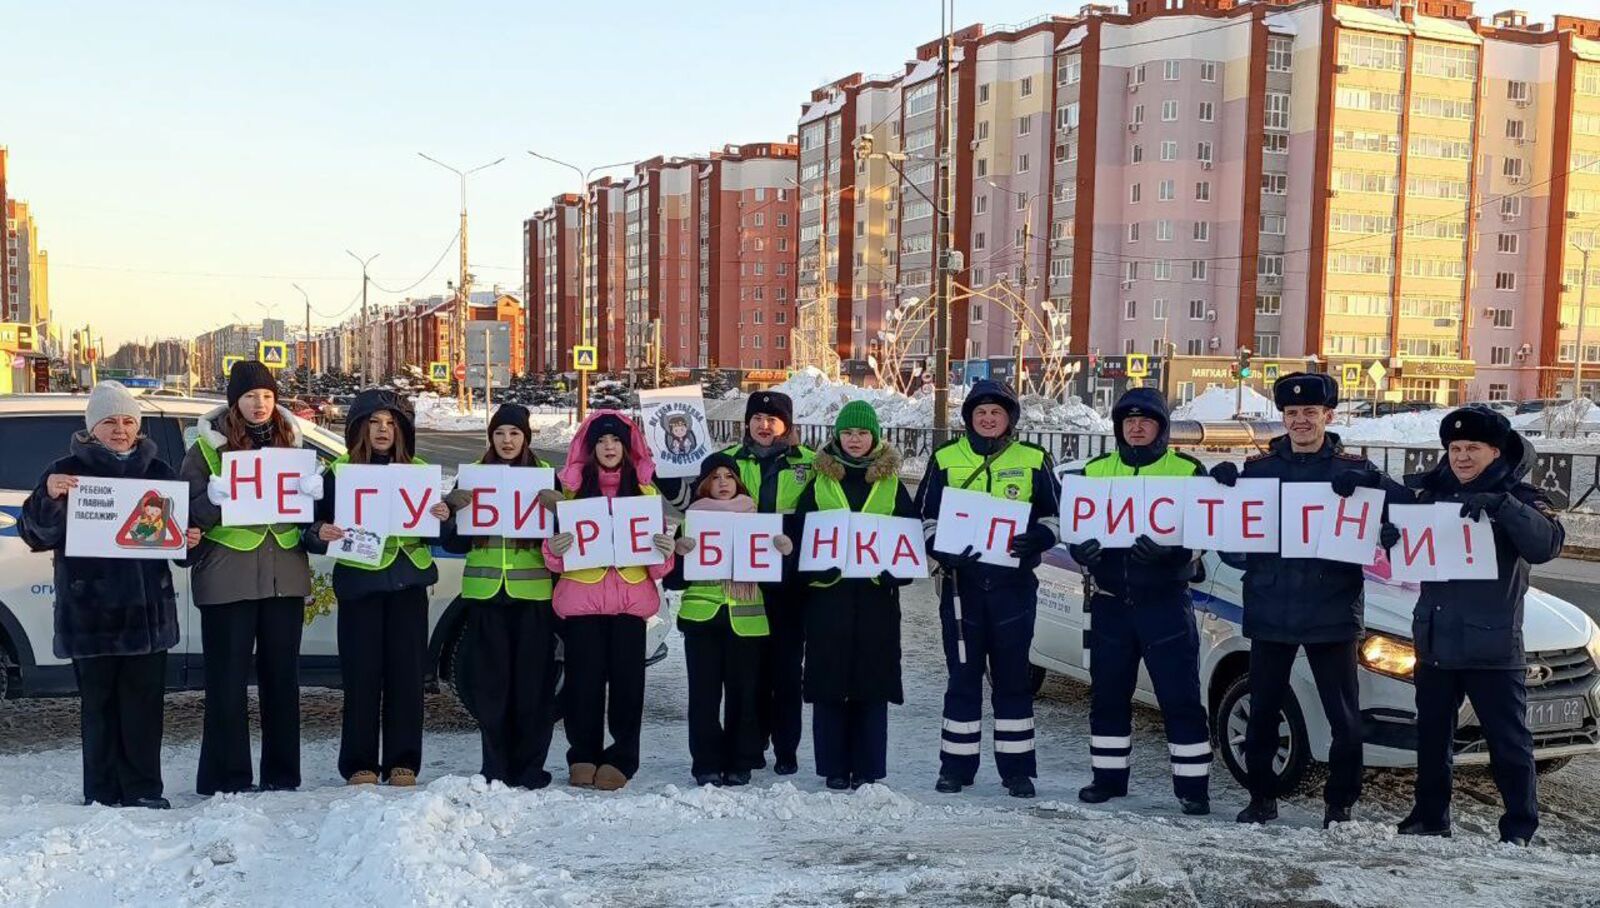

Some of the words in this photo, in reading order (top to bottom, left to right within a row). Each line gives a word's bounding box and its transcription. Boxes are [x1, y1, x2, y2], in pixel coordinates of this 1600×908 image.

[1192, 368, 1227, 378] МЯГКАЯ
[230, 457, 302, 515] НЕ
[78, 497, 115, 508] ГЛАВНЫЙ
[1564, 700, 1579, 716] 02
